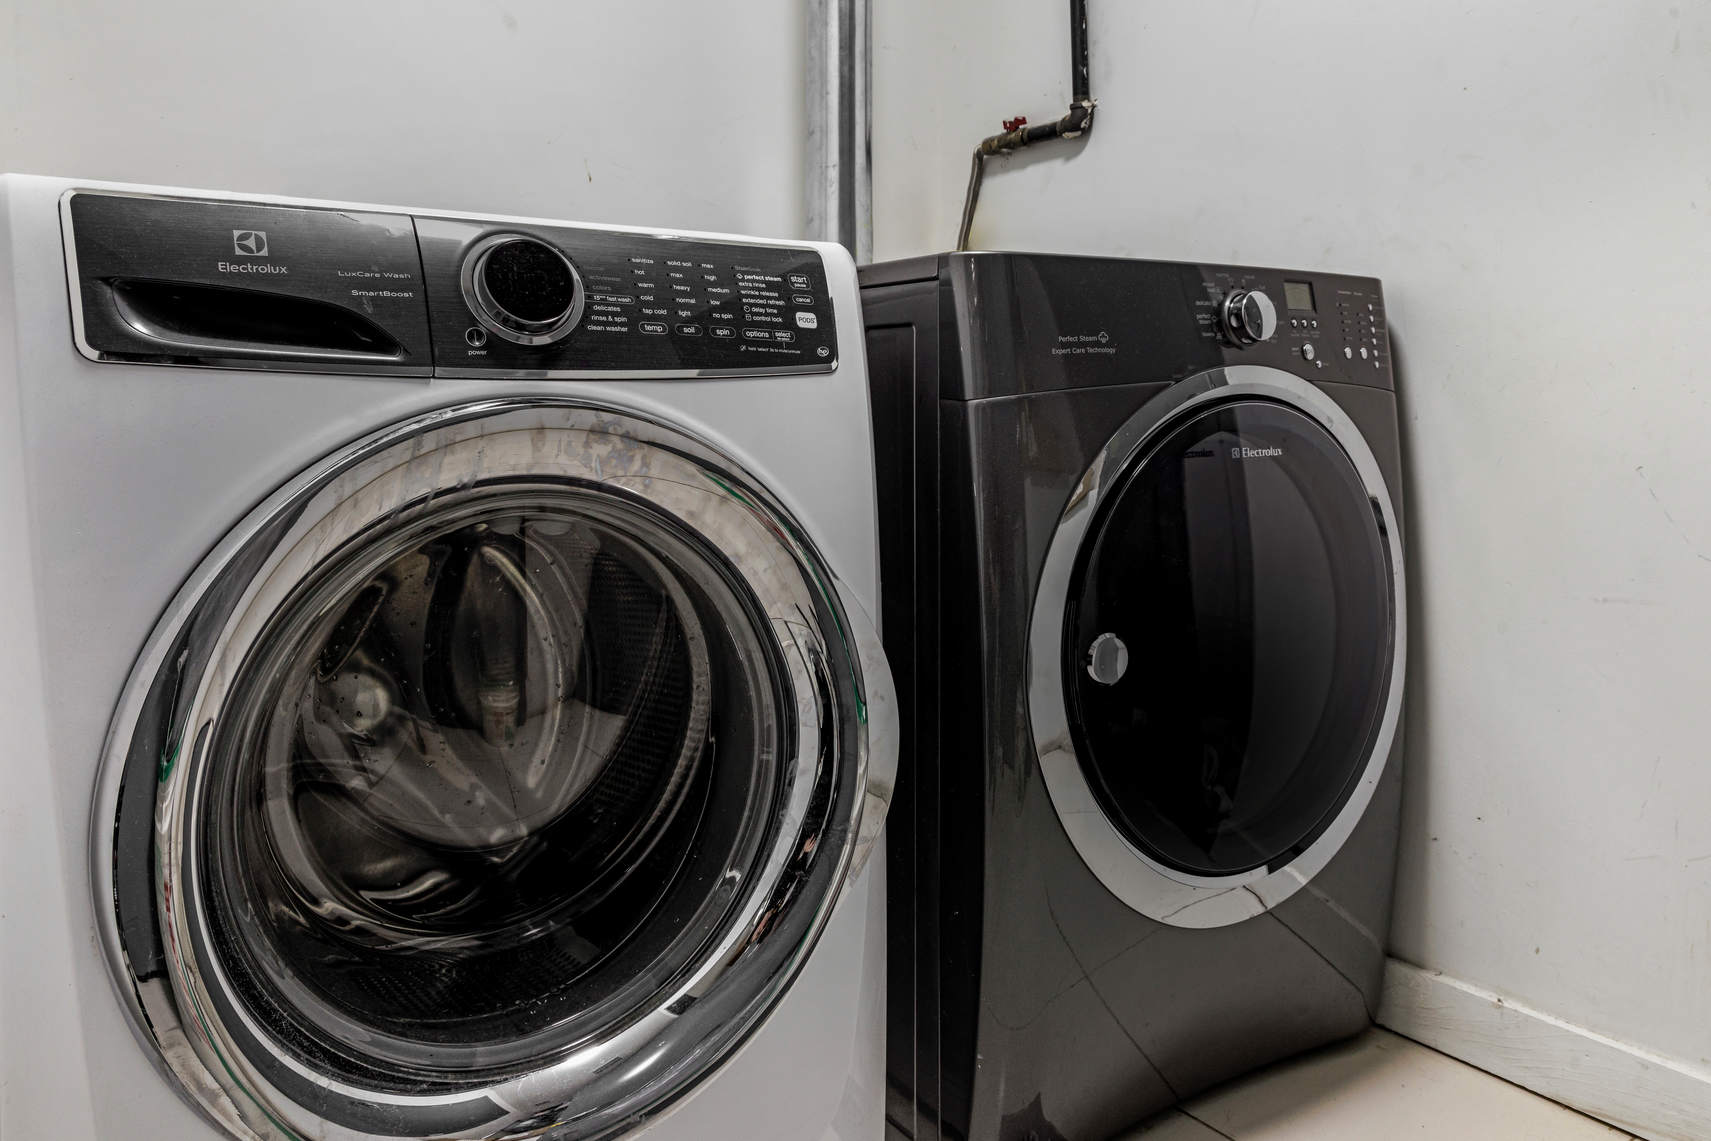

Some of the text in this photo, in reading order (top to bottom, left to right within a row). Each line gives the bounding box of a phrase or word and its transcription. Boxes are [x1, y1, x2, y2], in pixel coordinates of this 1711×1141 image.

[218, 261, 288, 274] Electrolux
[338, 270, 411, 279] LuxCare Wash
[704, 274, 717, 282] high
[790, 276, 807, 284] start
[673, 284, 691, 292] heavy
[707, 286, 730, 294] medium
[351, 289, 414, 298] SmartBoost
[593, 304, 621, 312] delicates
[642, 307, 653, 315] tap
[678, 309, 691, 317] light
[644, 324, 663, 332] temp
[716, 328, 730, 336] spin
[745, 330, 770, 338] options
[1052, 347, 1071, 355] Expert
[1087, 346, 1116, 354] Technology
[1242, 445, 1282, 458] Electrolux
